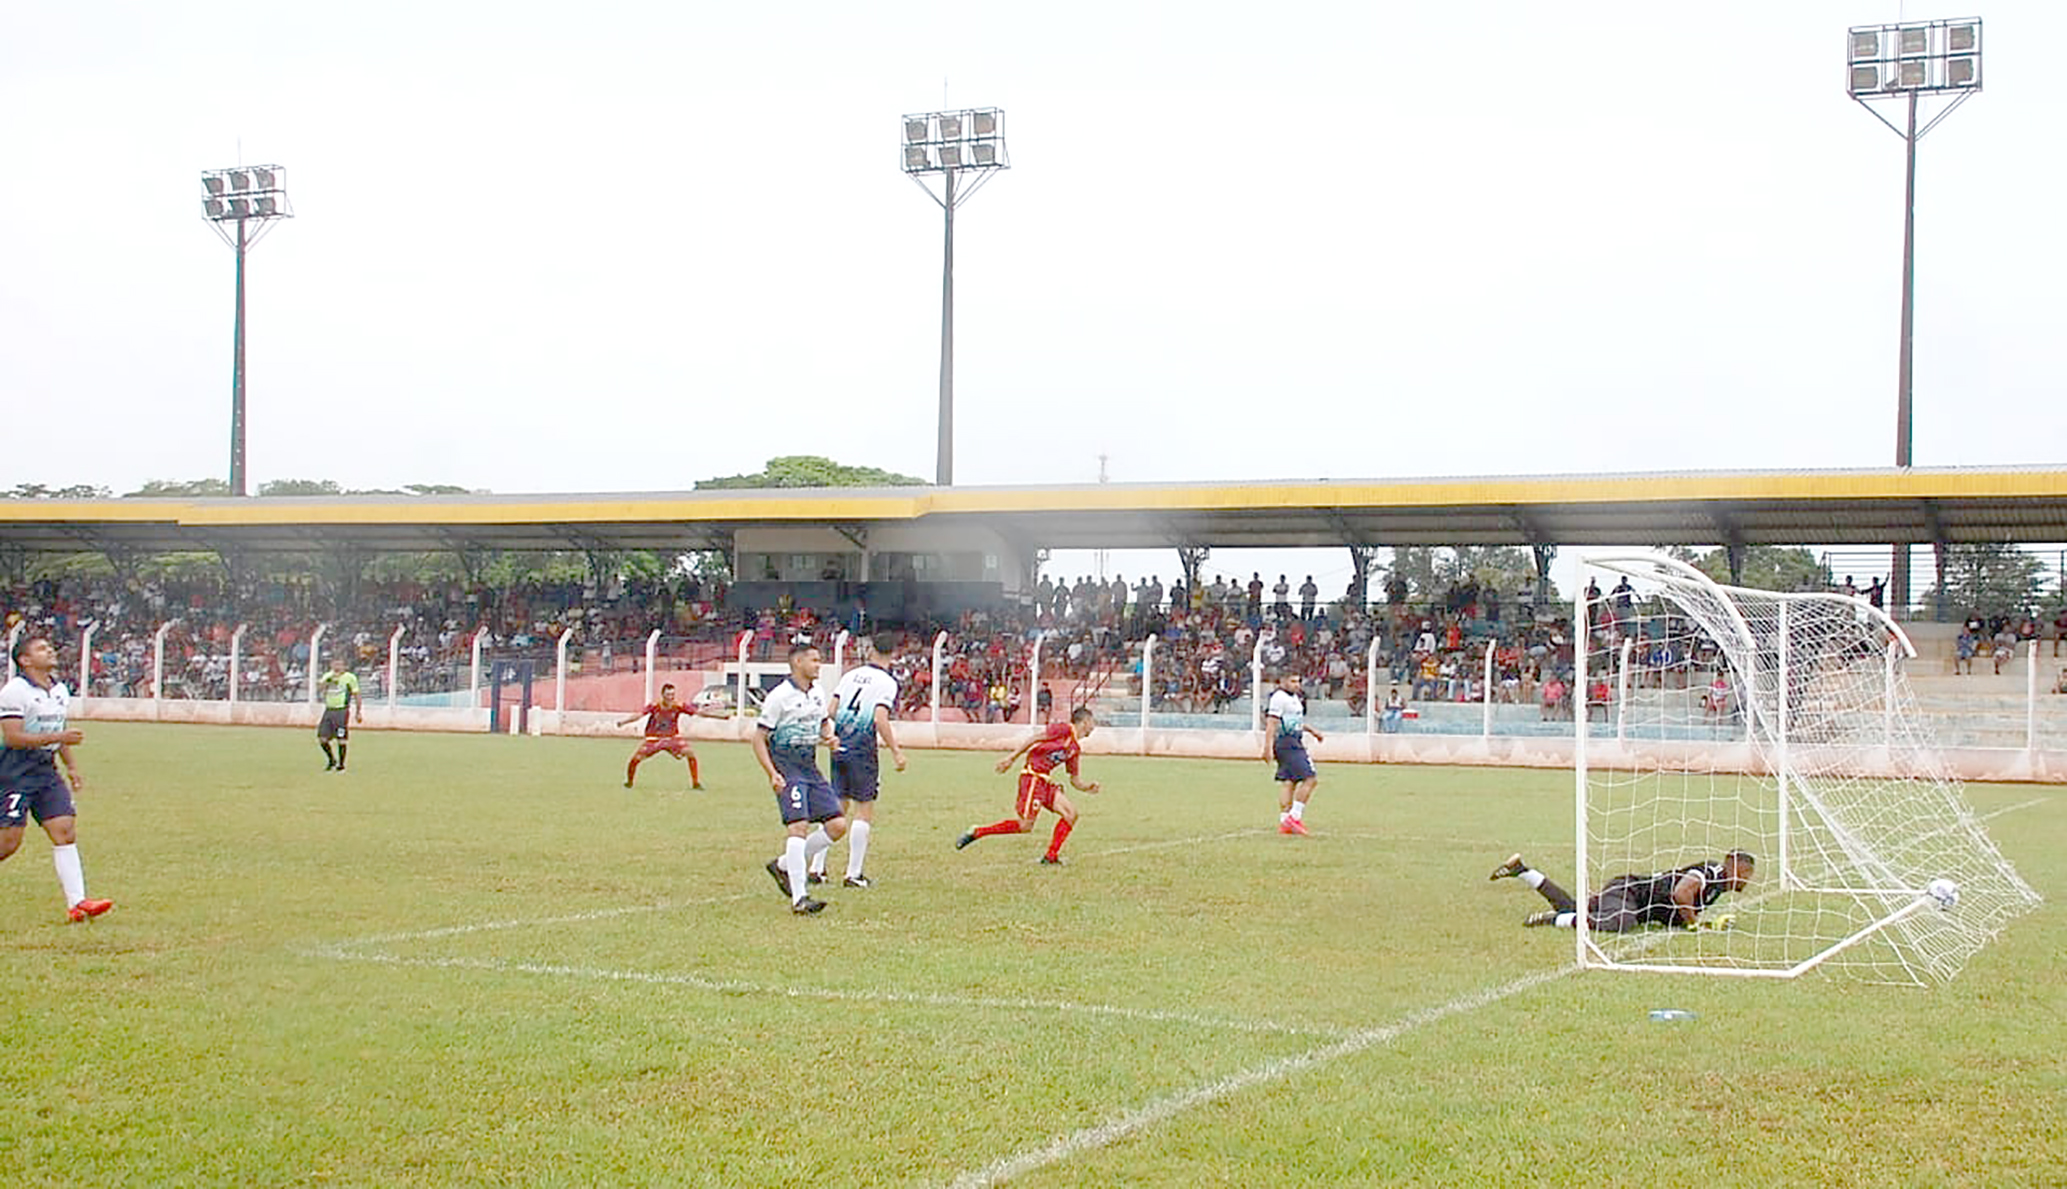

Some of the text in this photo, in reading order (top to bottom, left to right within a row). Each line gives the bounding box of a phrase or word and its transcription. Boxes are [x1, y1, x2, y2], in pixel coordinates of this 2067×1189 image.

[847, 687, 862, 717] 4
[8, 793, 22, 810] 7
[790, 785, 802, 801] 6
